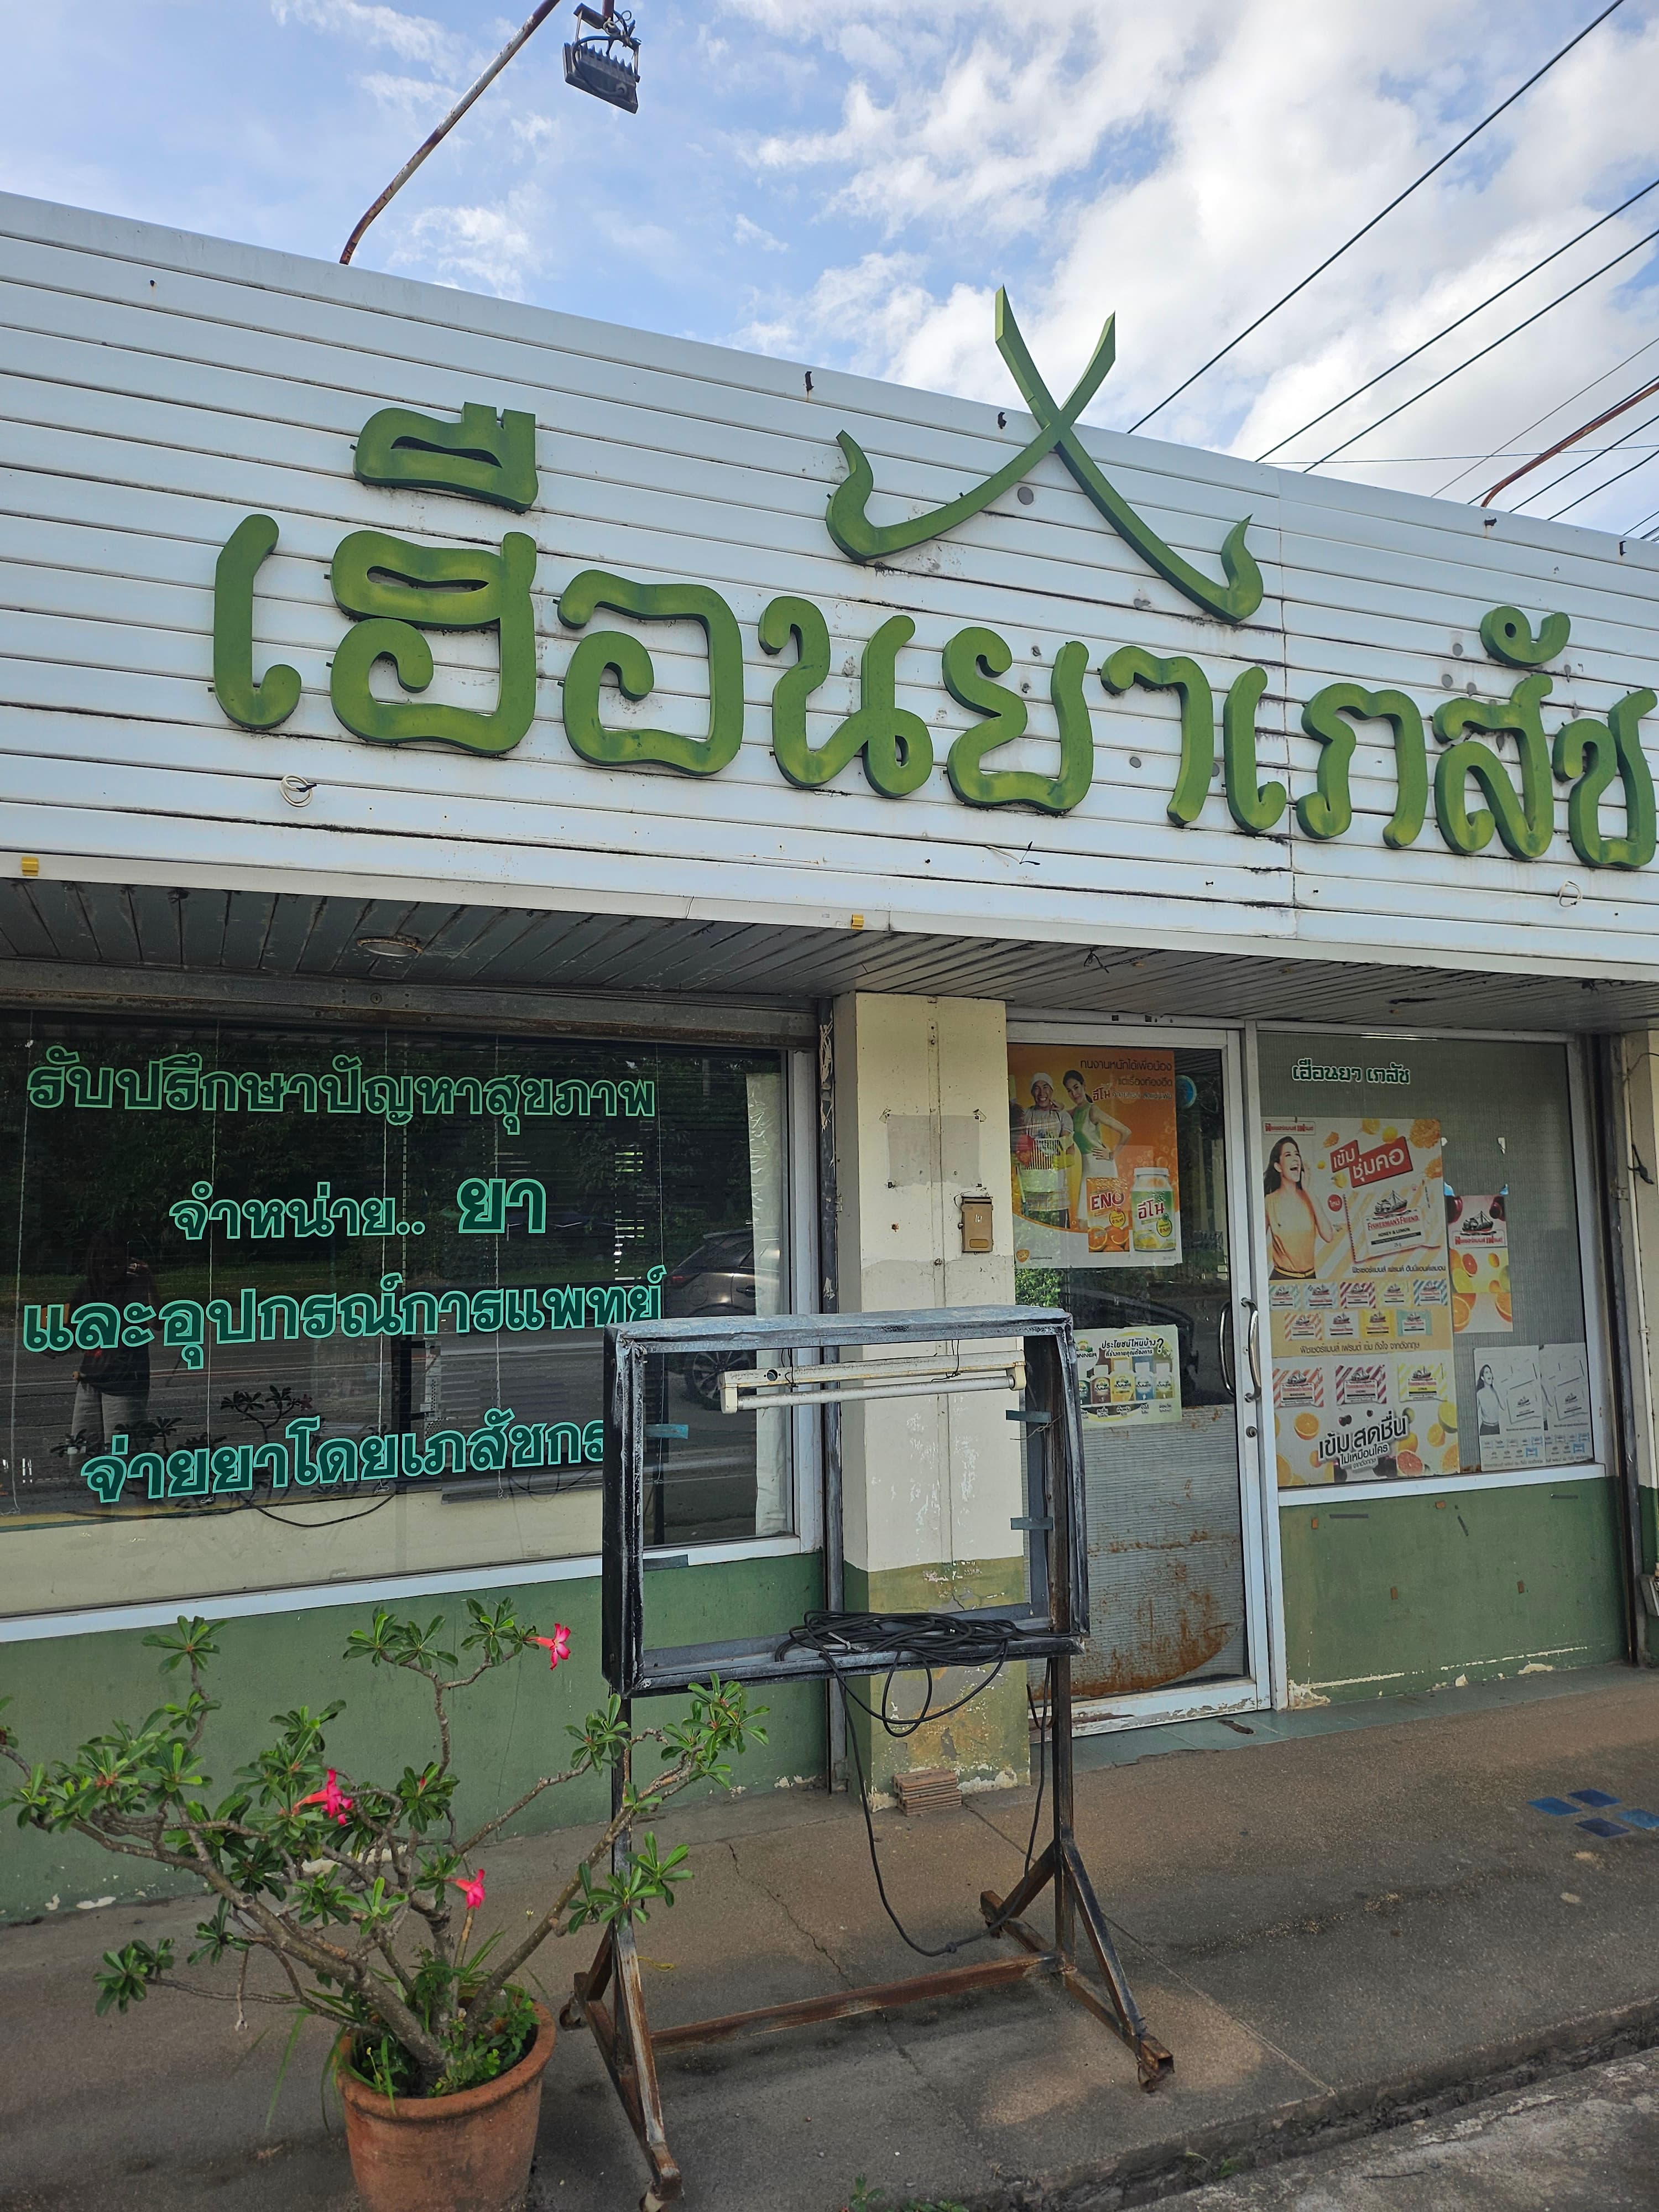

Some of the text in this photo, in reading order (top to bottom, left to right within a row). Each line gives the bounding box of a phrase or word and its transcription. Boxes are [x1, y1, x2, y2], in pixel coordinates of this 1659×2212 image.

[1366, 1062, 1410, 1084] เภสัช
[27, 1045, 655, 1135] รับปรึกษาปัญหาสุขภาพ
[1333, 1147, 1355, 1168] เข้ม
[1353, 1148, 1405, 1182] ชุ่มคอ
[457, 1178, 546, 1234] ยา
[1091, 1191, 1124, 1211] ENO
[1138, 1199, 1165, 1219] อีโน
[23, 1265, 667, 1370] และอุปกรณ์การแพทย์
[1319, 1410, 1407, 1459] เข้ม สดชื่น
[1340, 1442, 1389, 1465] ไม่เหมือนใคร
